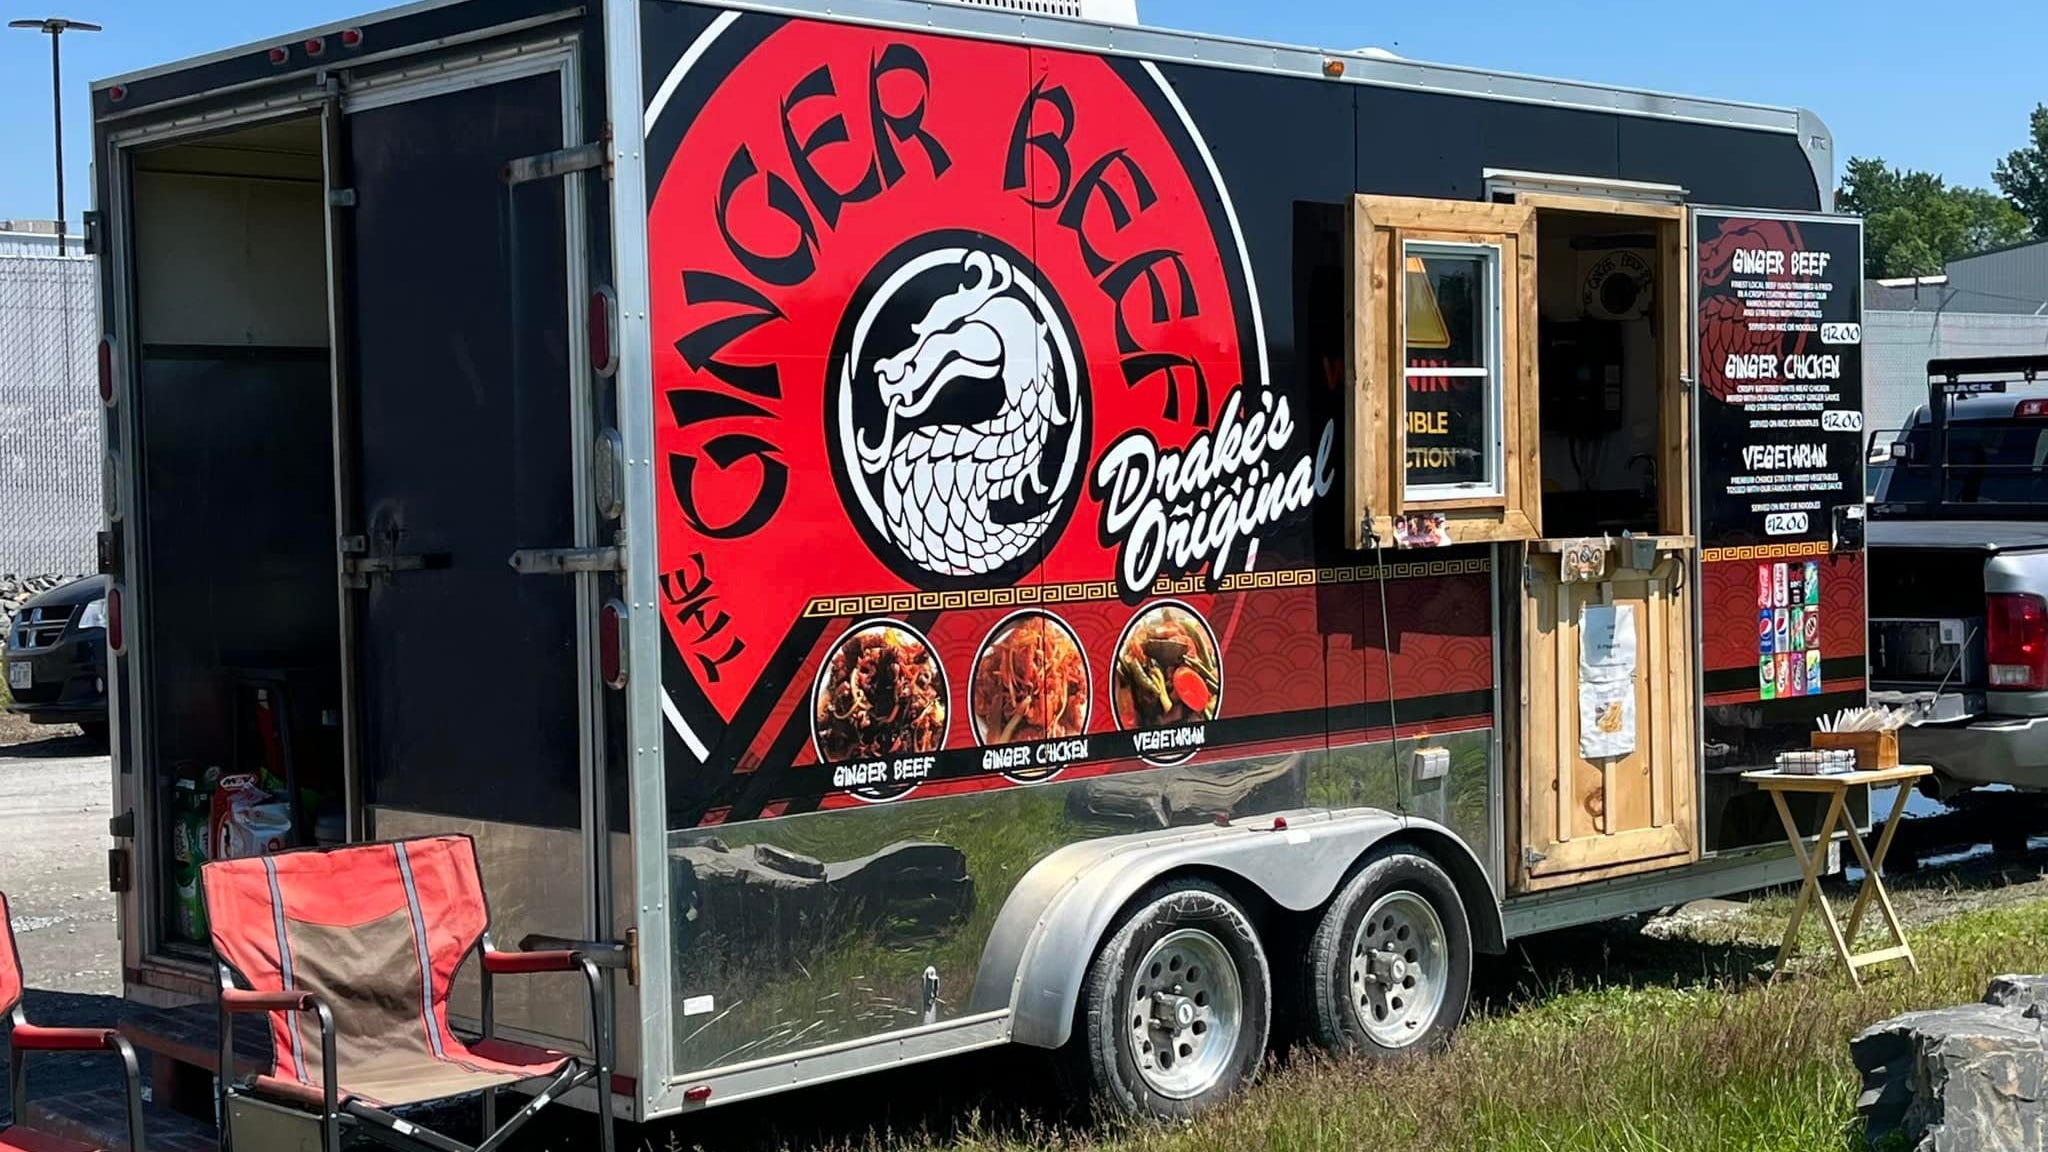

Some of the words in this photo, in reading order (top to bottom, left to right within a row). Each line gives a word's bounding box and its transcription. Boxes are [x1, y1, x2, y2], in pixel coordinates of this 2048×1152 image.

[1004, 75, 1209, 427] BEEF
[1733, 249, 1784, 274] GINGER
[1791, 252, 1831, 276] BEEF
[666, 43, 952, 540] GINGER
[1725, 354, 1777, 378] GINGER
[1784, 355, 1840, 379] CHICKEN
[1098, 390, 1295, 534] Drake's
[1742, 443, 1828, 470] VEGETARIAN
[1124, 418, 1335, 592] Original
[659, 552, 746, 683] THE
[982, 744, 1031, 770] GINGER
[1036, 736, 1088, 767] CHICKEN
[1134, 725, 1206, 752] VEGETARIAN
[833, 761, 887, 788] GINGER
[893, 756, 936, 782] BEEF
